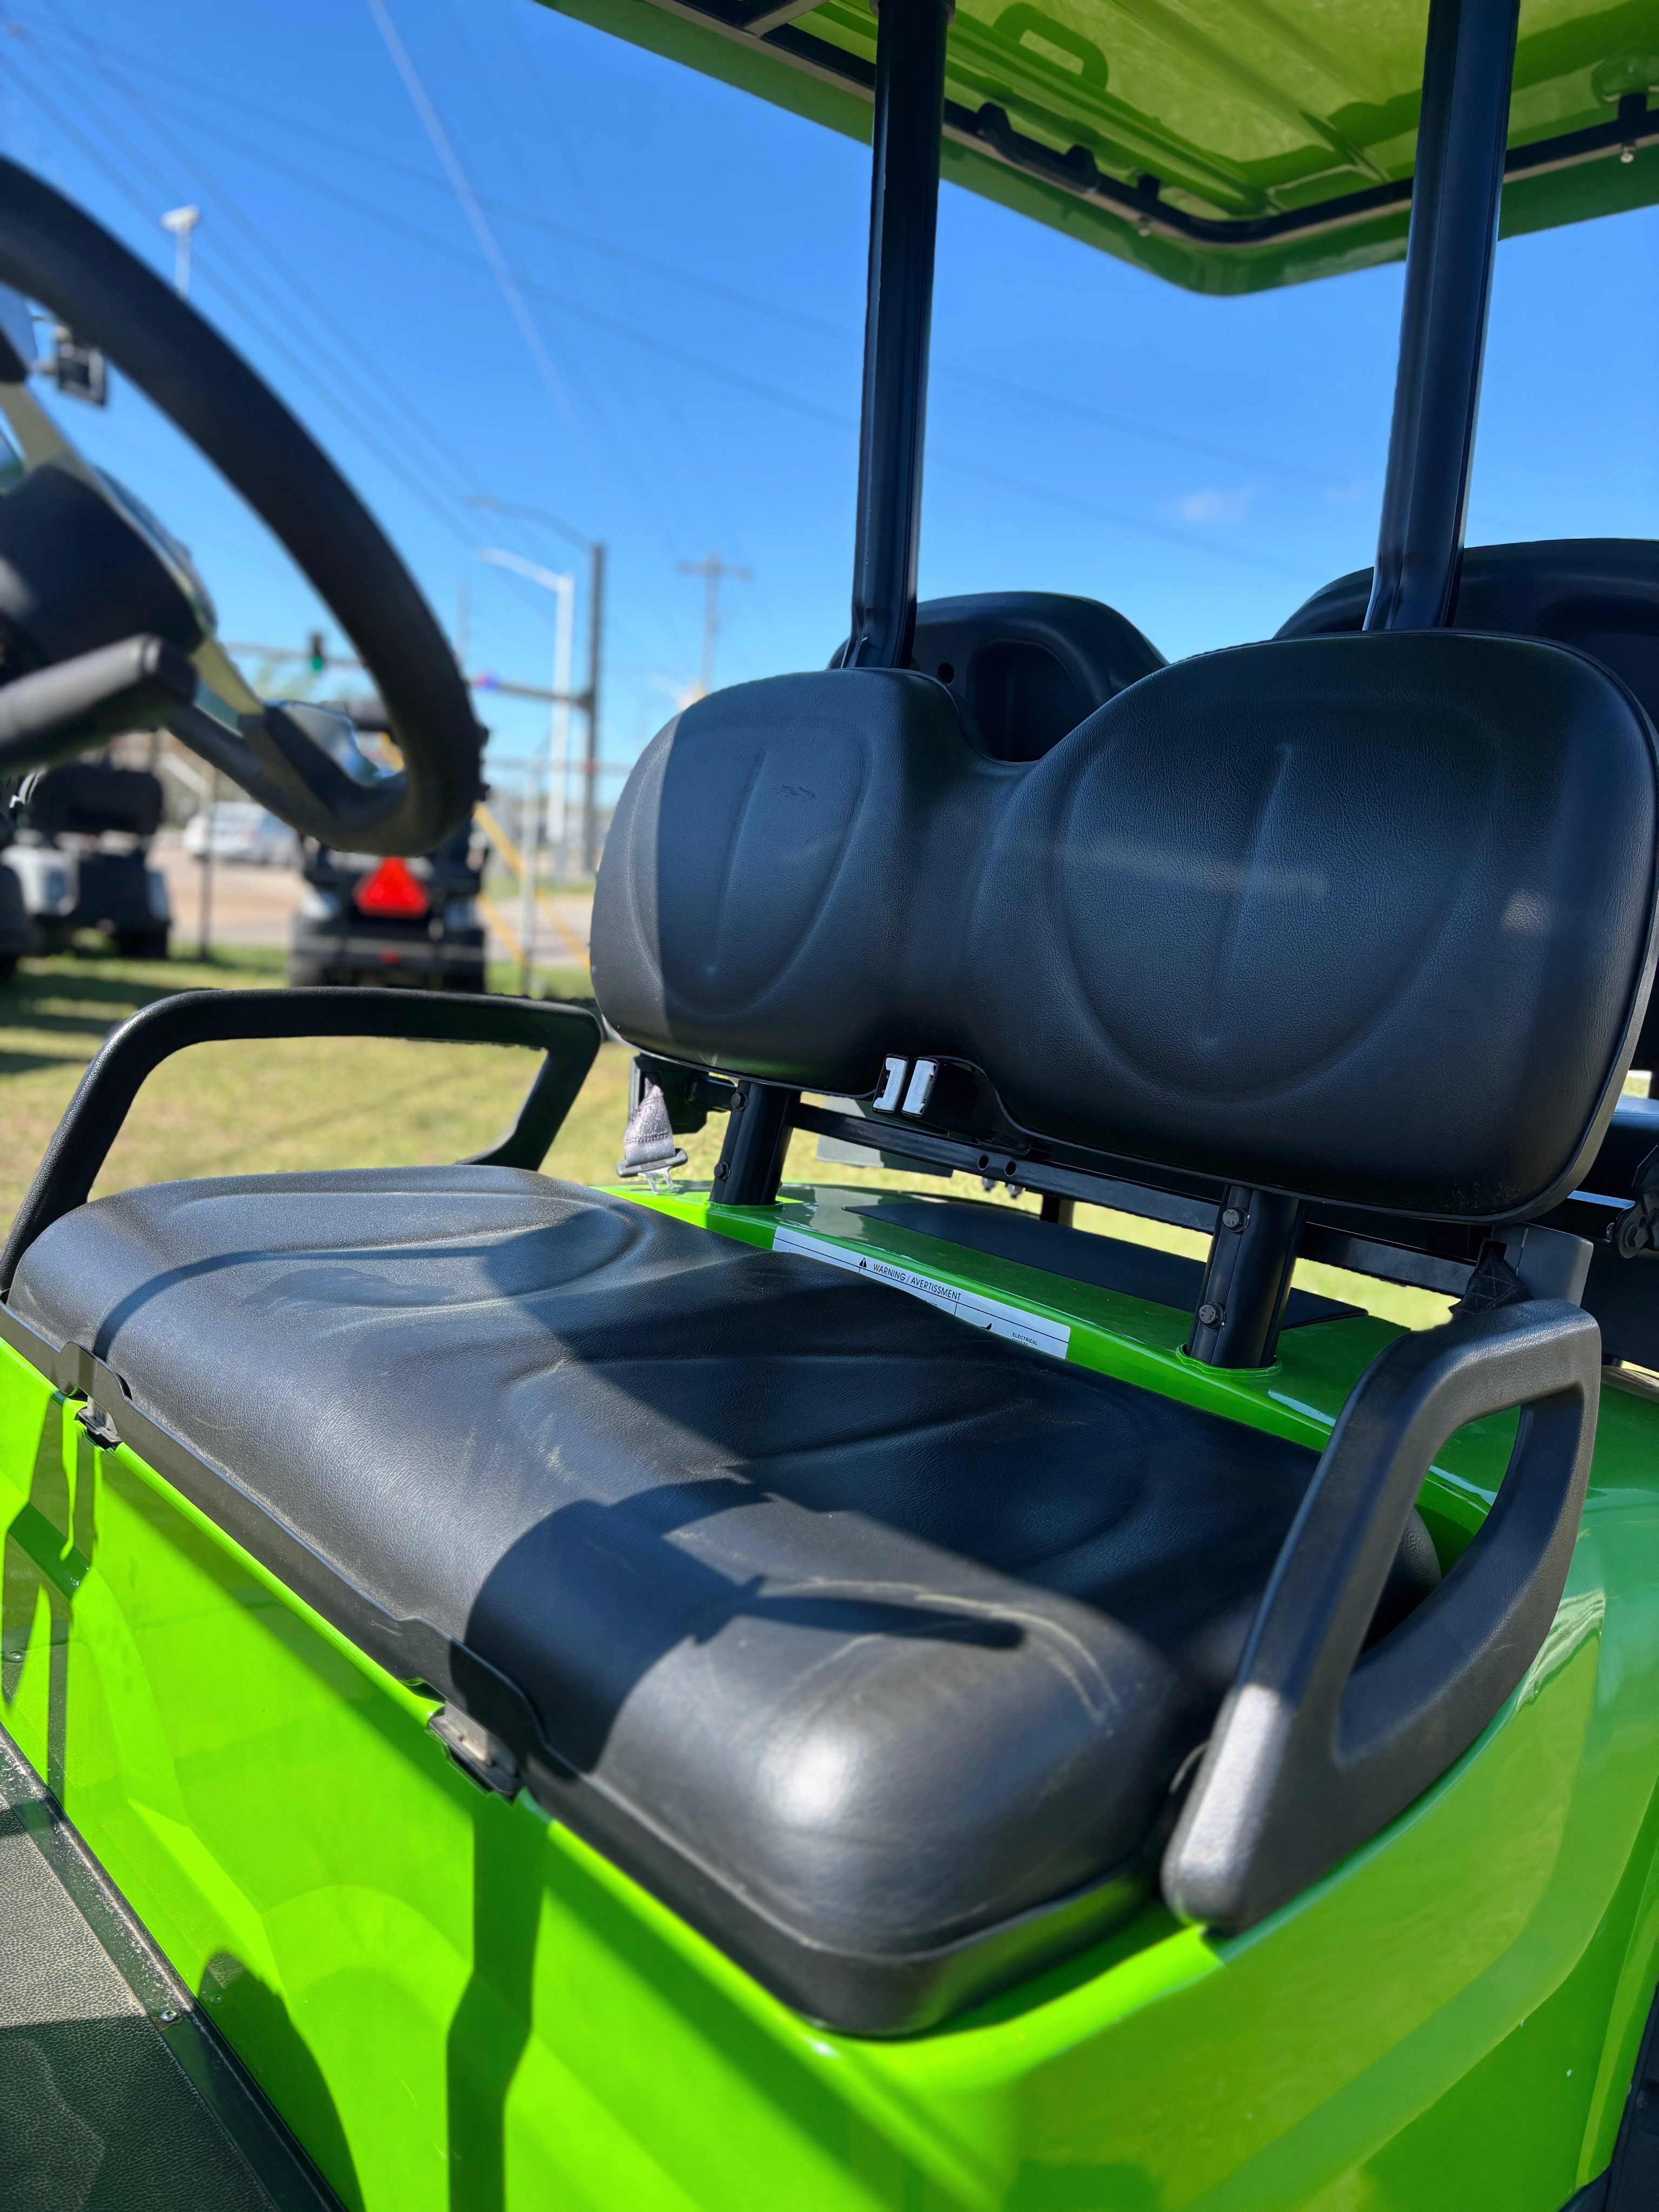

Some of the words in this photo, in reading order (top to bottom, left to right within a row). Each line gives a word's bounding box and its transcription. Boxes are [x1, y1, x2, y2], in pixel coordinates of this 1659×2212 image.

[873, 1263, 906, 1282] WARNING
[906, 1275, 911, 1283] /
[910, 1277, 961, 1301] AVERTISSMENT
[1012, 1332, 1038, 1345] ELECTRICAL
